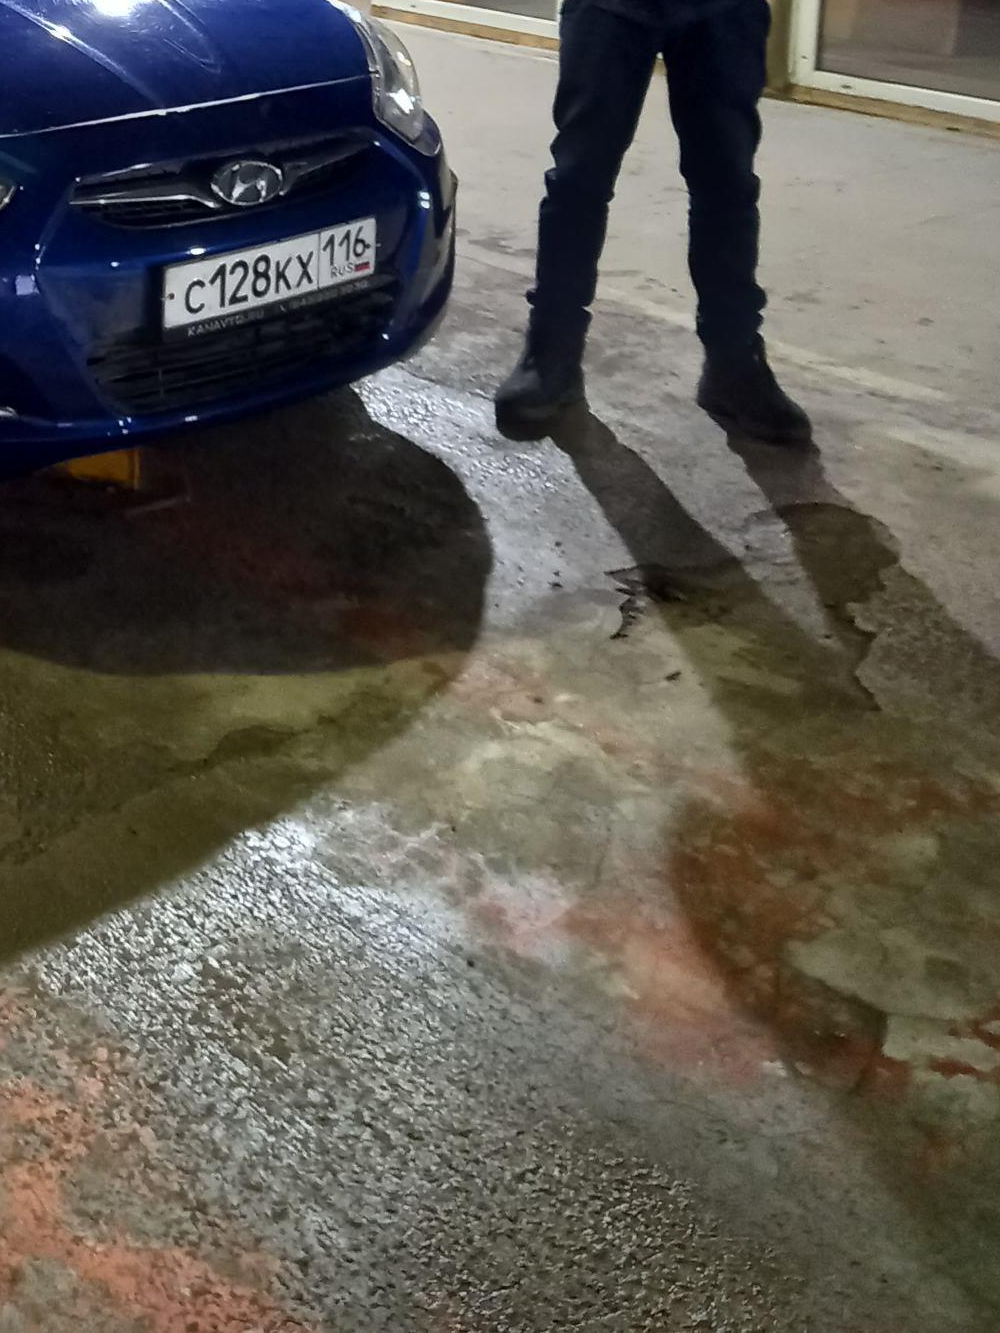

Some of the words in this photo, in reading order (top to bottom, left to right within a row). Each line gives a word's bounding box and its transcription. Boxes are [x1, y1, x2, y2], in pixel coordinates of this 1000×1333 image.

[184, 251, 314, 314] С128КХ
[322, 225, 364, 267] 116
[330, 262, 355, 279] RUS
